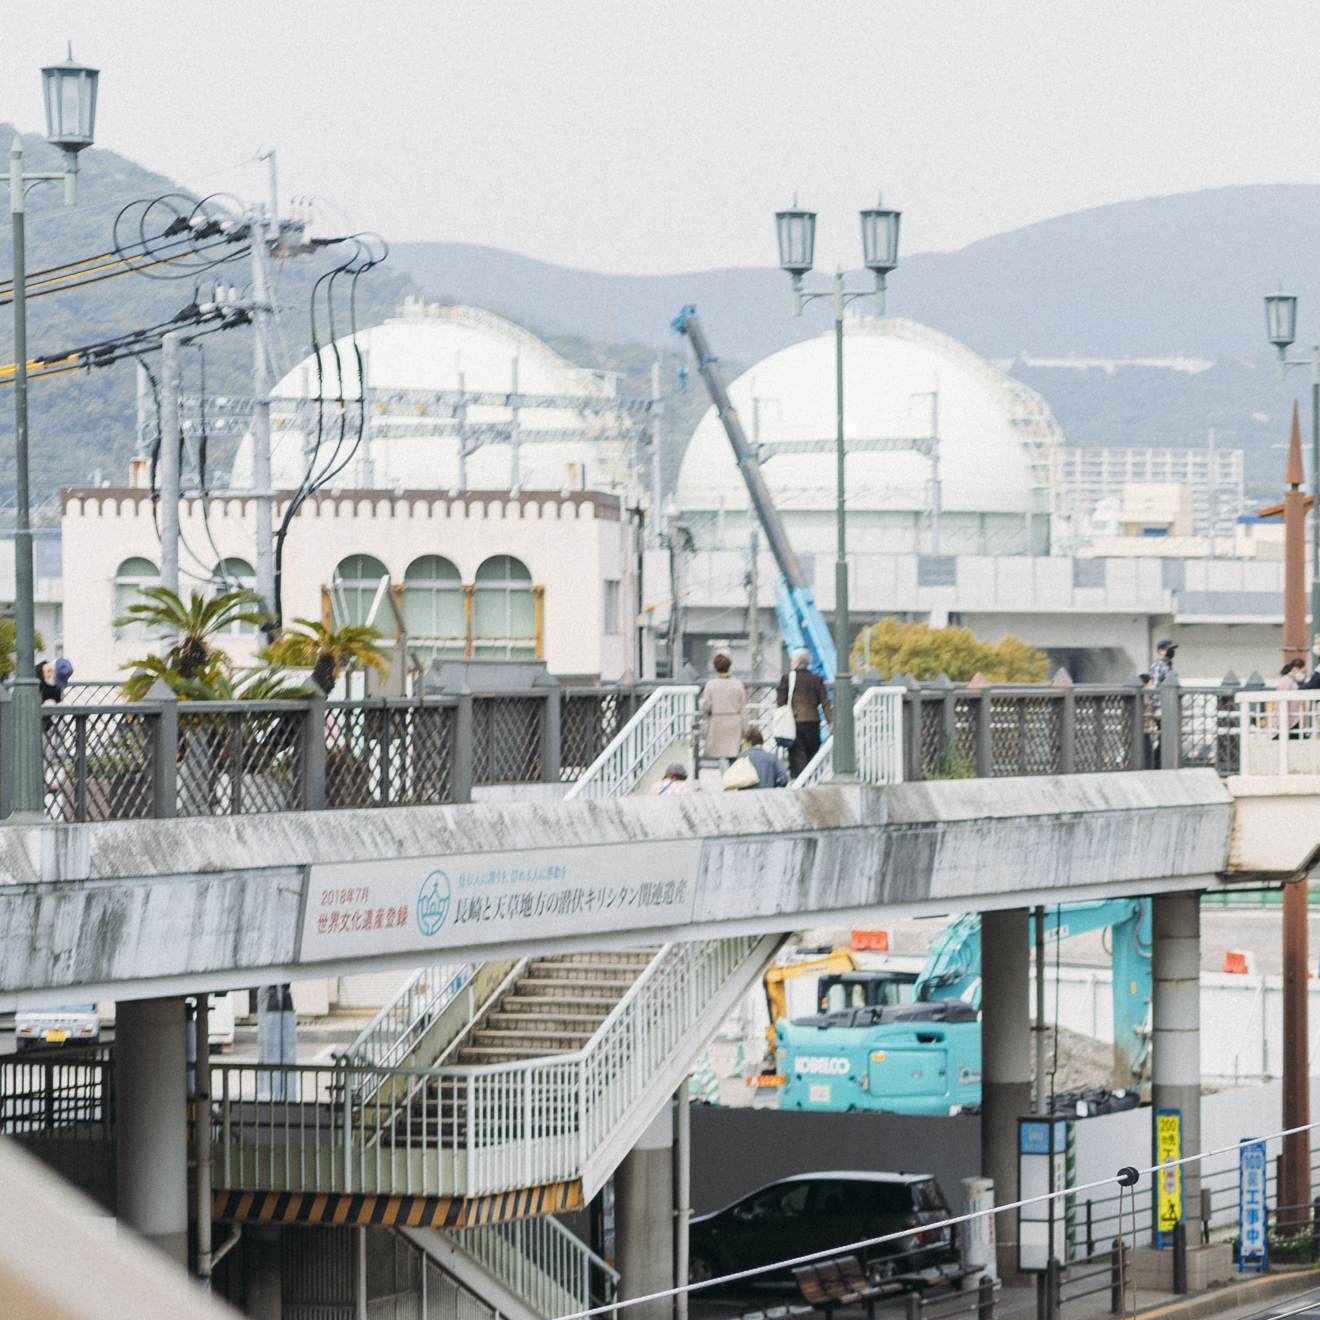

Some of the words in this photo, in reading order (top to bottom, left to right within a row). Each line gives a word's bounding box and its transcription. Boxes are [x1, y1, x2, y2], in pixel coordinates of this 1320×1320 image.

[320, 886, 370, 907] 2018年7月
[453, 878, 688, 925] 長崎と天草地方の潜伏キリシタン関連遺産
[317, 905, 409, 935] 世界文化遺産登録
[795, 1056, 850, 1075] KOBELCO
